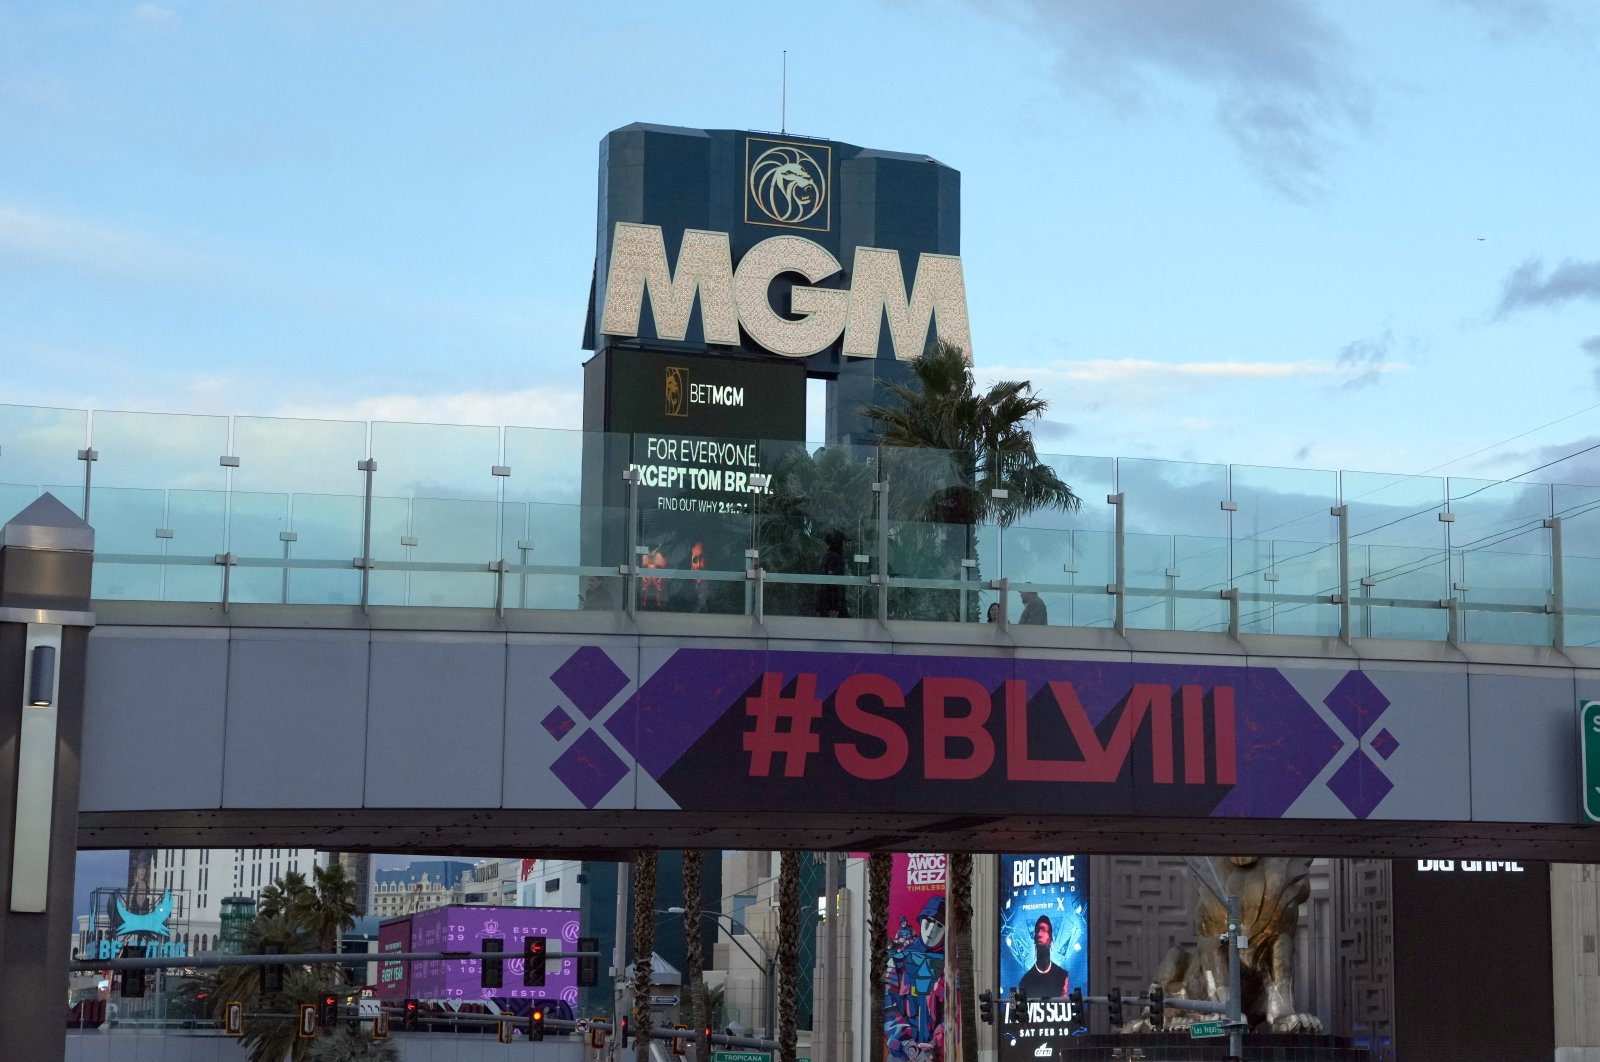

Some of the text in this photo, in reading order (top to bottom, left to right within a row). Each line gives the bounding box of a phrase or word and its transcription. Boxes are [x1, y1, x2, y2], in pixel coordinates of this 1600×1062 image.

[600, 221, 974, 368] MGM
[690, 383, 744, 407] BETMGM
[647, 437, 760, 468] FOR EVERYONE.
[629, 463, 687, 489] XCEPT
[688, 467, 721, 491] TOM
[657, 497, 678, 512] FIND
[679, 498, 697, 512] OUT
[698, 500, 718, 513] WHY
[743, 671, 1237, 785] #SBLVIII
[907, 869, 946, 885] KEEZ
[1013, 855, 1075, 887] BIG GAME
[908, 884, 946, 892] TIMELESS
[1013, 885, 1076, 897] WEEKEND
[1019, 1027, 1069, 1038] SAT FEB 10
[724, 1054, 763, 1062] TROPICANA
